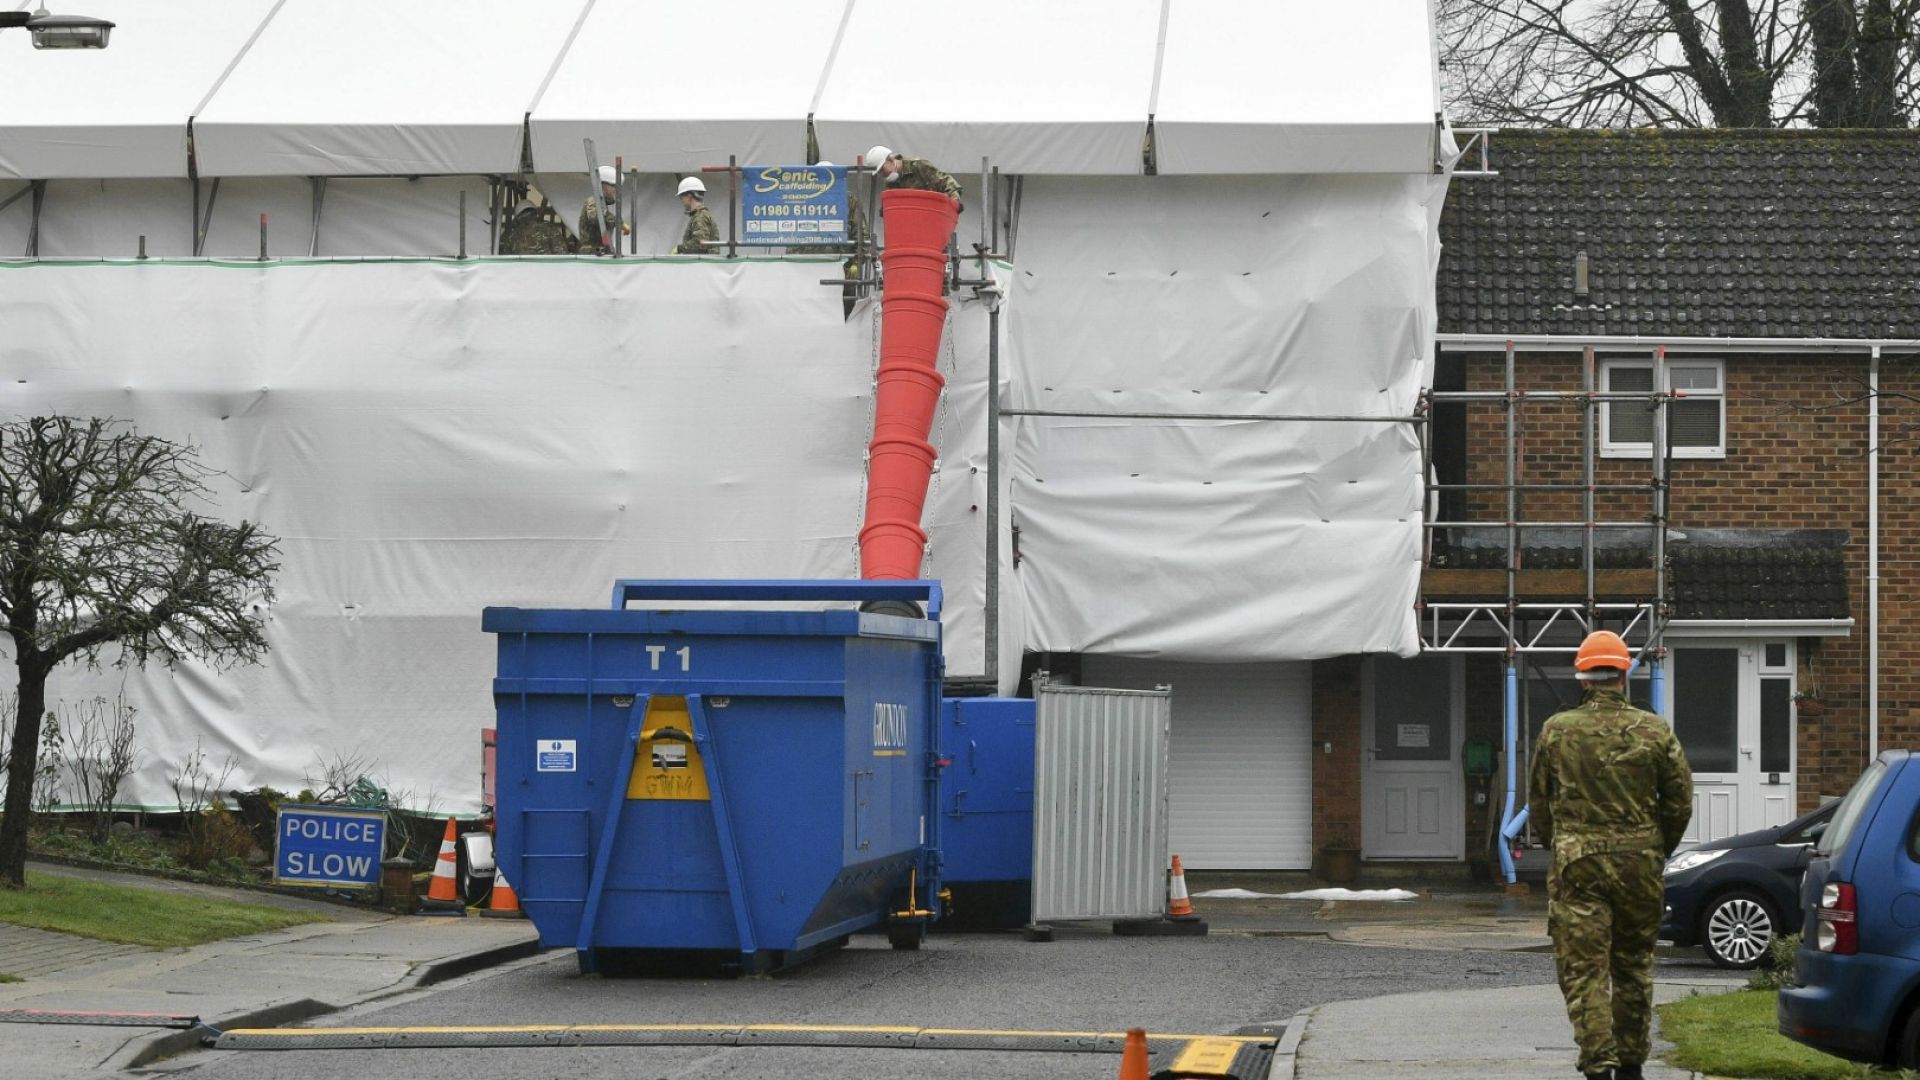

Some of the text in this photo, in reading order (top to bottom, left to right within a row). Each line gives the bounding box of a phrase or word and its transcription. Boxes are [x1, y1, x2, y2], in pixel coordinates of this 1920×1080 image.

[753, 204, 838, 216] 01980 619114
[645, 645, 690, 671] T 1
[286, 818, 376, 843] POLICE
[287, 851, 372, 878] SLOW
